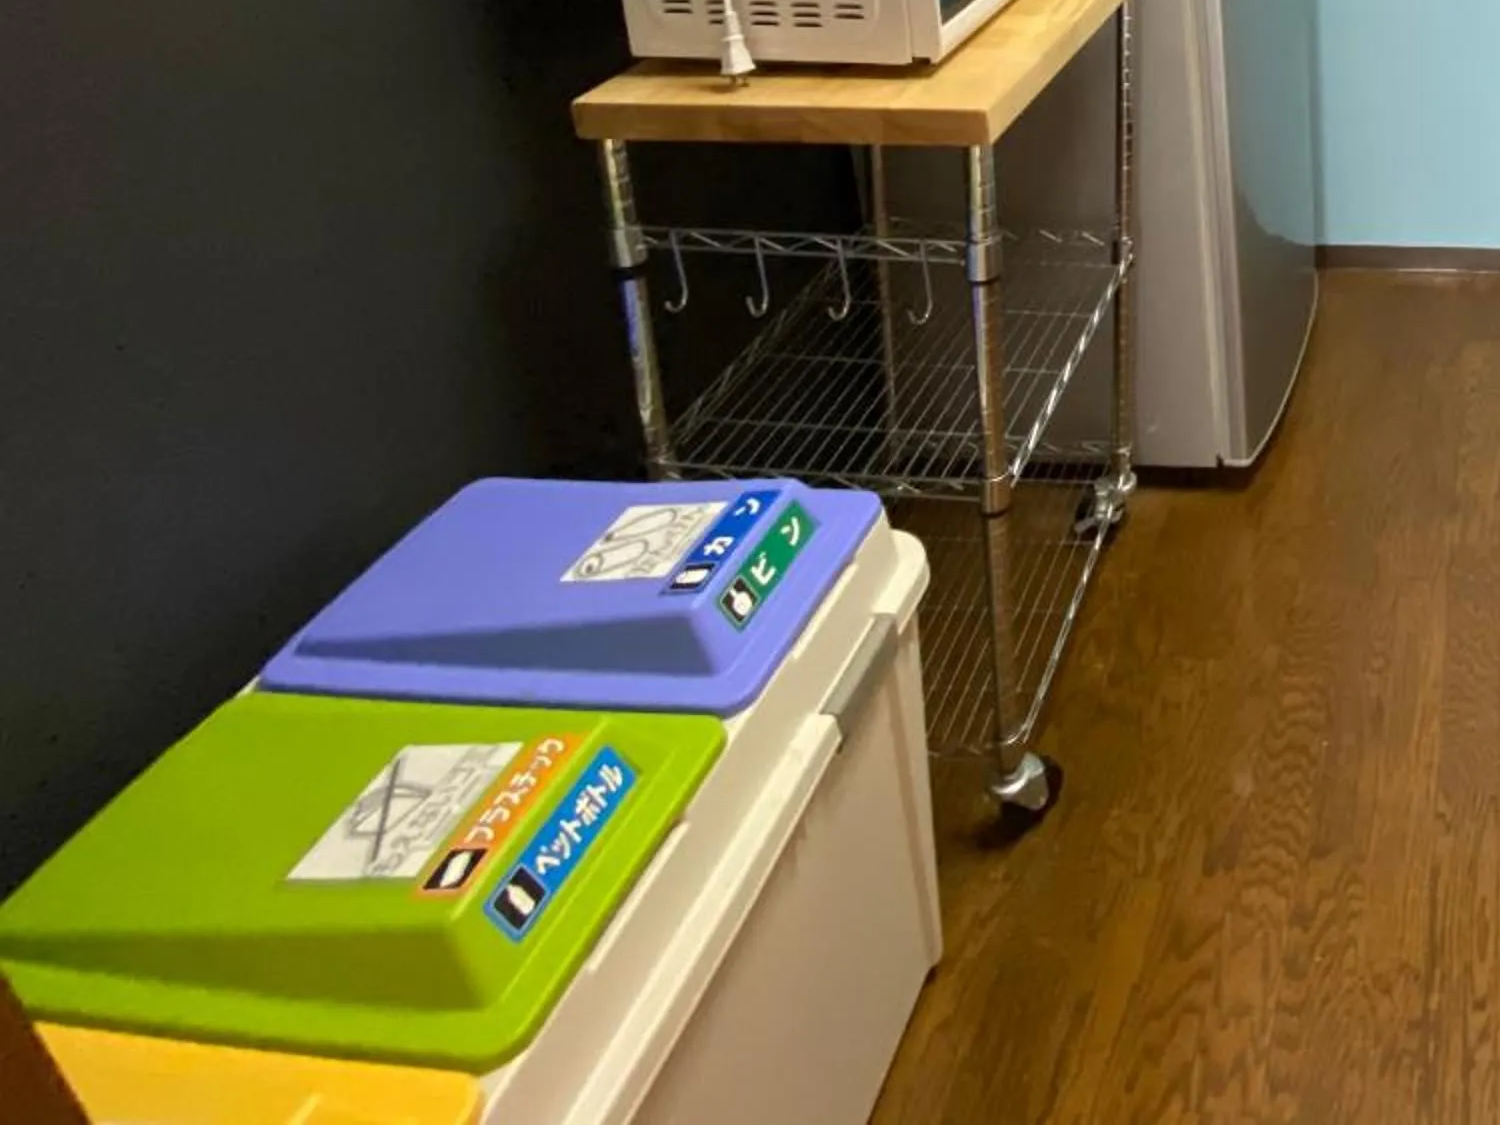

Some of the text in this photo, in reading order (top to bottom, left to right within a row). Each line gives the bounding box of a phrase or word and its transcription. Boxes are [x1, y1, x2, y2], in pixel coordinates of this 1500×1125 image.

[703, 498, 760, 556] カン
[750, 516, 800, 586] ビン
[534, 762, 623, 875] ペットボトル
